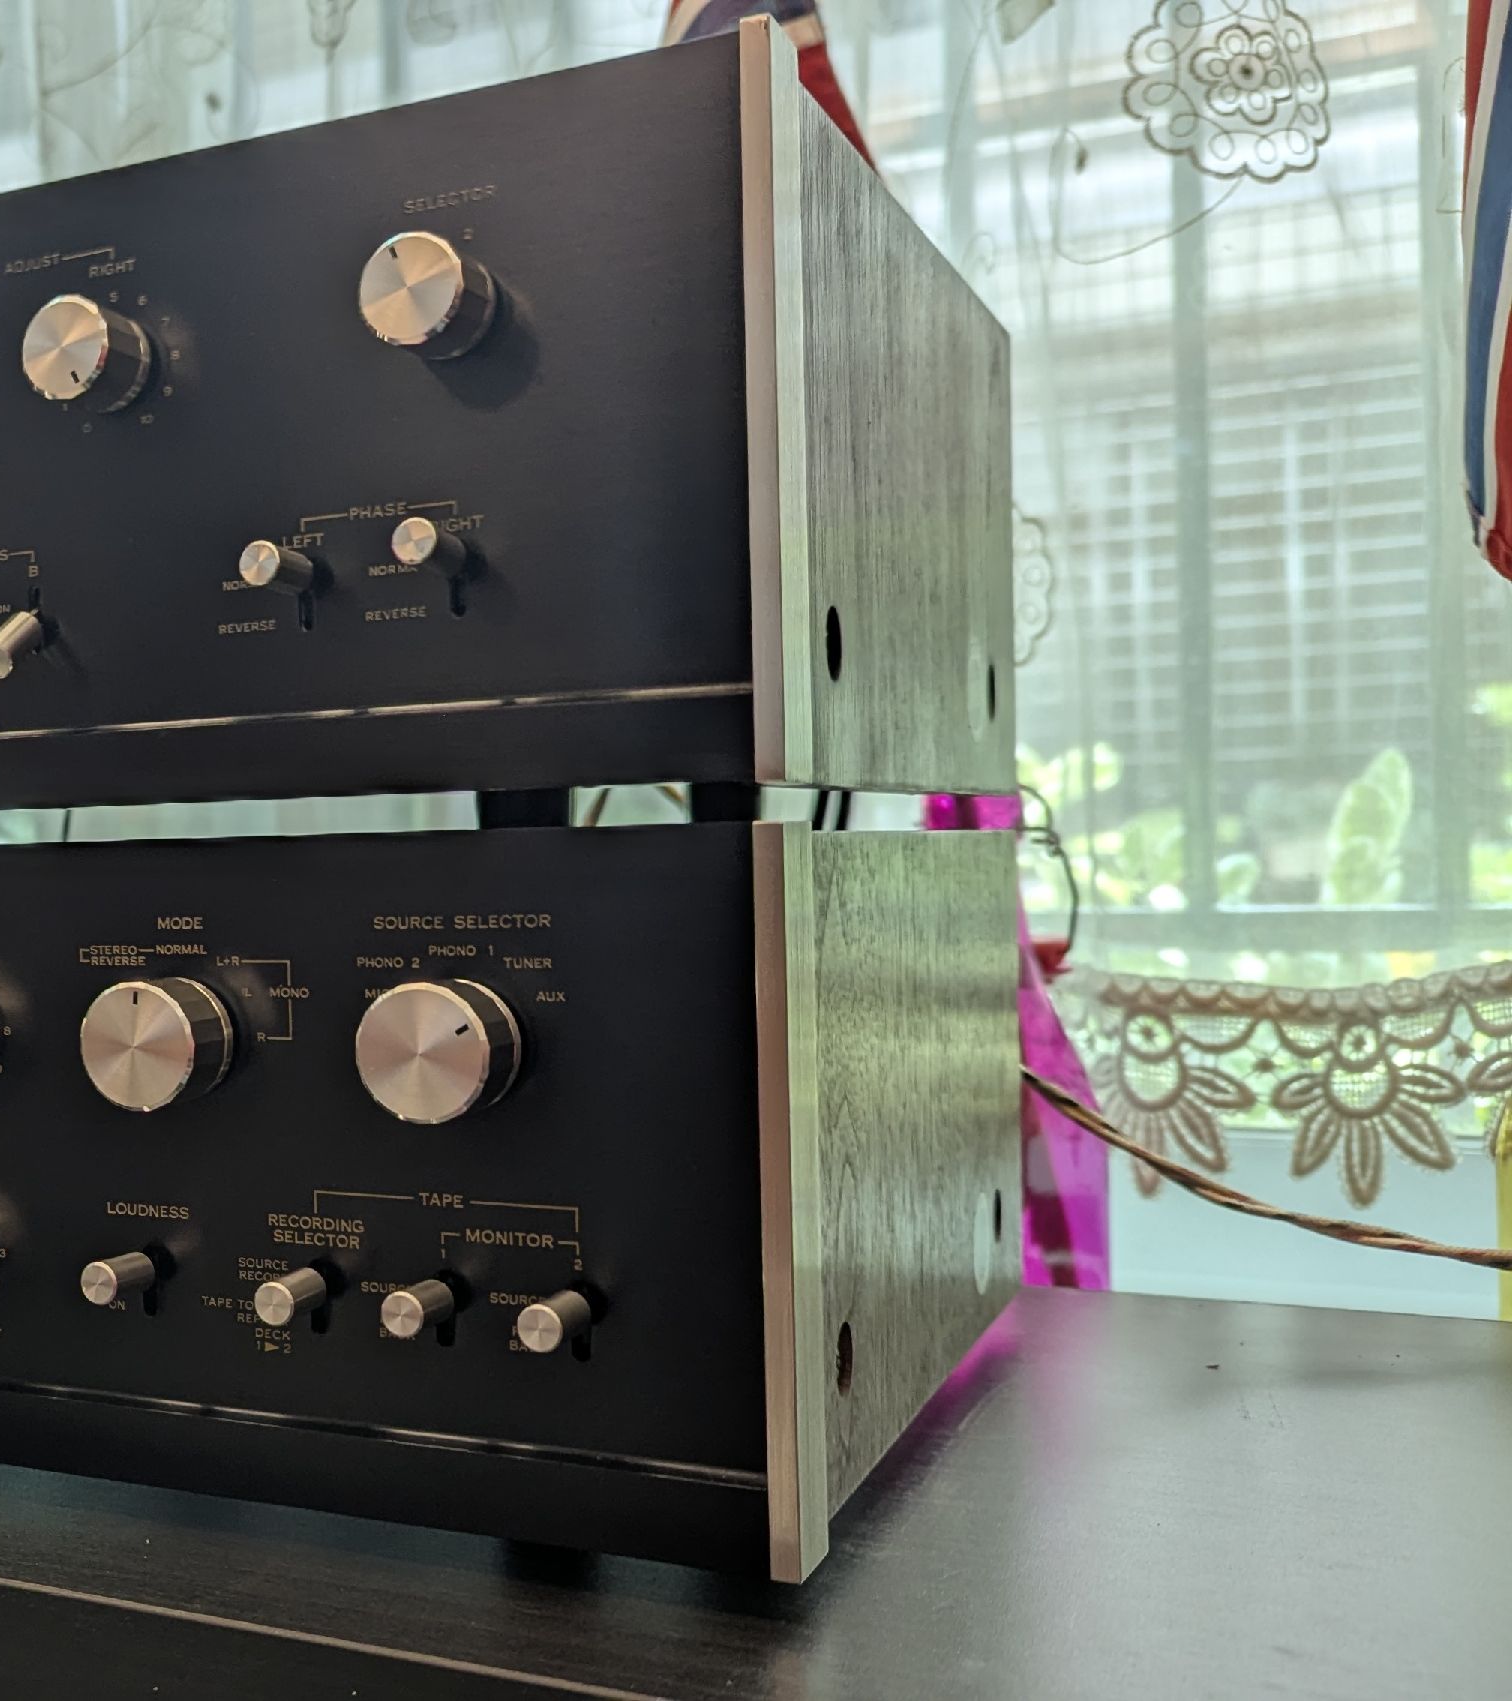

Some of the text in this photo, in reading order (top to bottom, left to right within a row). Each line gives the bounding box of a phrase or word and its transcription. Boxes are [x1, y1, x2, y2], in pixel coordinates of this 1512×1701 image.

[403, 184, 497, 214] SELECTOR
[4, 253, 61, 274] ADJUST
[88, 258, 136, 278] RIGHT
[349, 503, 408, 520] PHASE
[282, 533, 325, 548] LEFT
[28, 565, 39, 578] B
[365, 606, 428, 622] REVERSE
[218, 620, 277, 635] REVERSE
[156, 916, 204, 930] MODE
[373, 913, 552, 930] SOURCE SELECTOR
[89, 944, 207, 956] STEREO NORMAL
[428, 945, 477, 957] PHONO
[90, 956, 146, 967] REVERSE
[216, 955, 240, 967] L+R
[356, 957, 420, 969] PHONO 2
[503, 957, 553, 969] TUNER
[269, 986, 309, 999] MONO
[364, 988, 389, 999] MI
[536, 991, 566, 1003] AUX
[3, 1025, 12, 1036] 8
[256, 1032, 266, 1043] R
[419, 1192, 464, 1209] TAPE
[106, 1201, 189, 1219] LOUDNESS
[268, 1214, 365, 1233] RECORDING
[273, 1230, 360, 1249] SELECTOR
[465, 1228, 554, 1248] MONITOR
[238, 1257, 289, 1271] SOURCE
[573, 1259, 583, 1271] 2
[239, 1270, 282, 1282] RECOR
[360, 1281, 407, 1293] SOUR
[108, 1299, 126, 1311] ON
[202, 1296, 254, 1311] TAPE TO
[255, 1328, 291, 1341] DECK
[283, 1343, 292, 1354] 2
